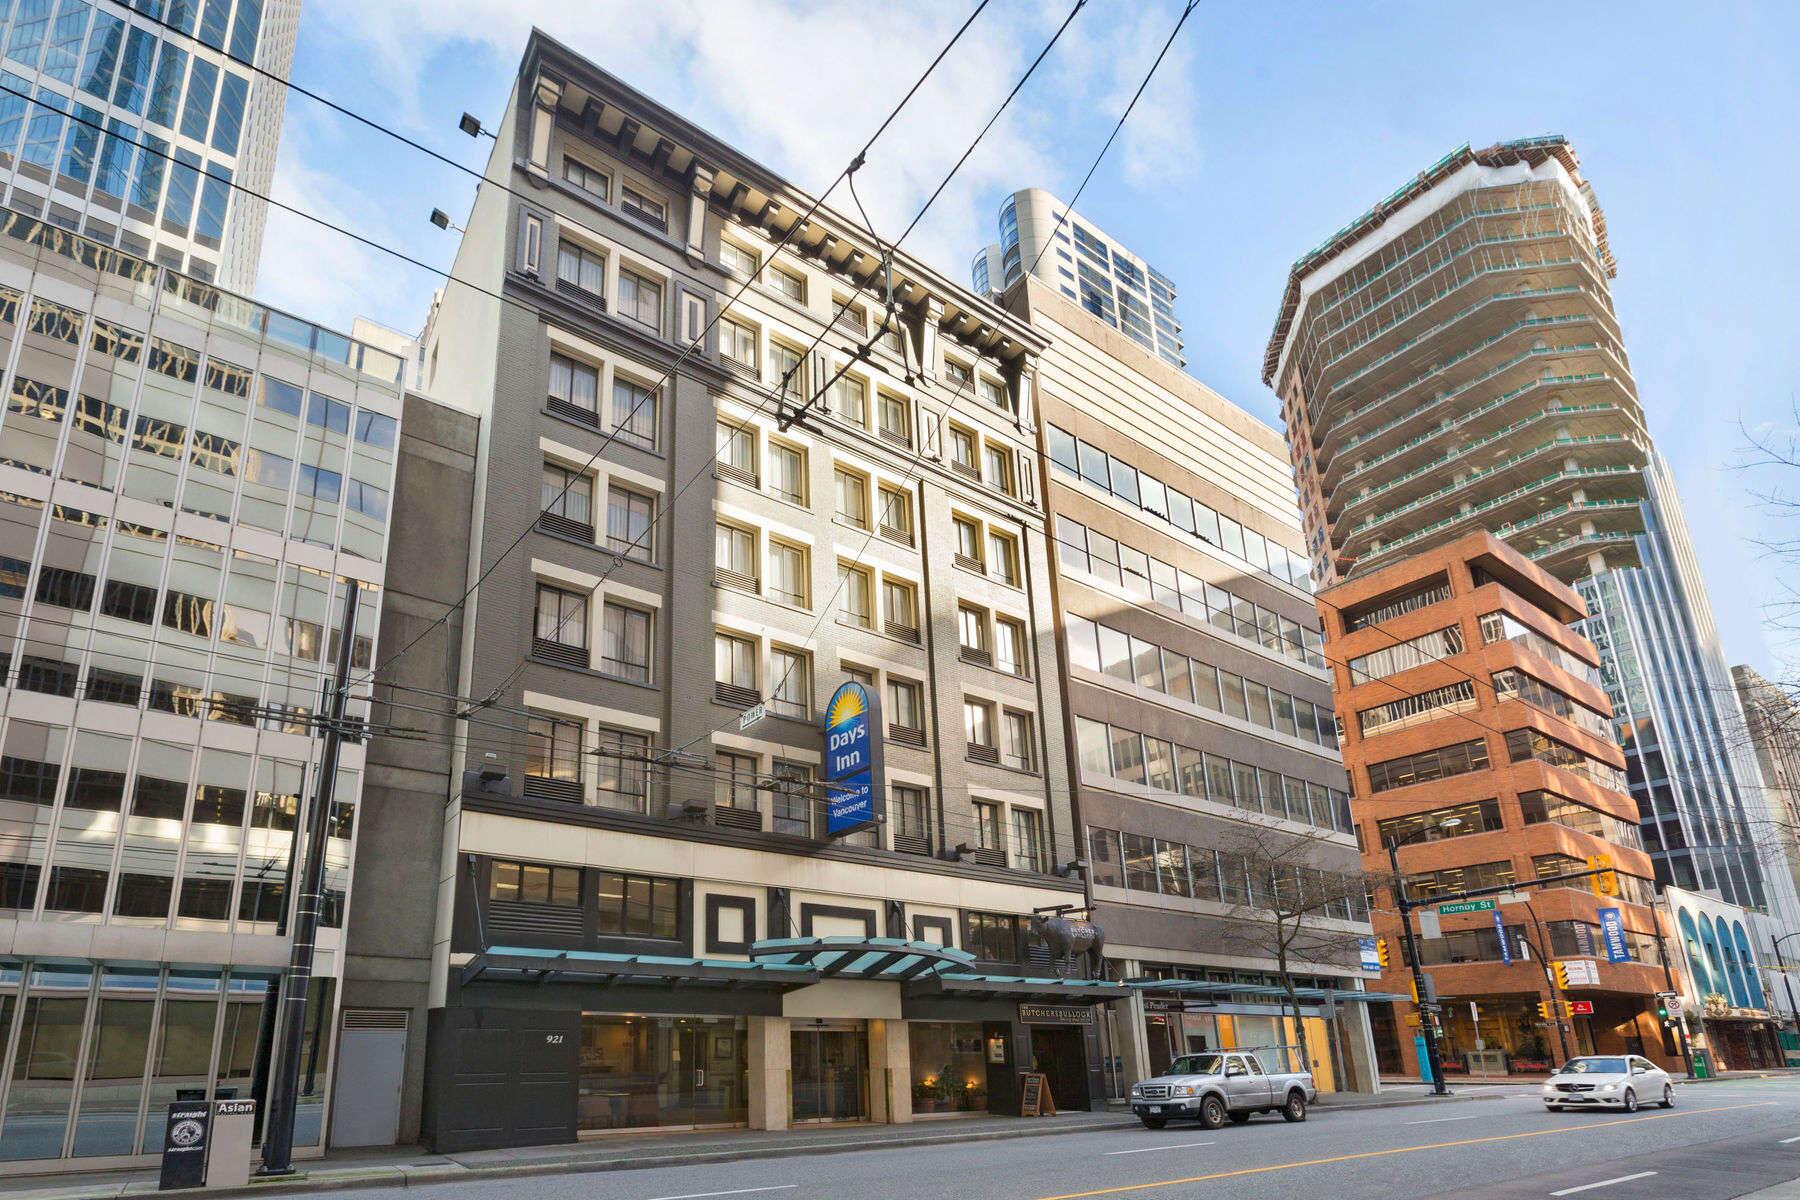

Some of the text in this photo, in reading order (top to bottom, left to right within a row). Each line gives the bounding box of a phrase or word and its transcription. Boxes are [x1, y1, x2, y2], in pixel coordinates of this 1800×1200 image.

[830, 724, 865, 751] Days
[836, 750, 860, 771] Inn
[861, 786, 869, 794] to
[833, 800, 867, 818] Vancouver
[1442, 900, 1491, 913] Hornby St
[1605, 921, 1625, 959] TAMWOOD
[546, 1035, 564, 1043] 921
[218, 1103, 253, 1113] Asian
[171, 1111, 207, 1119] straight
